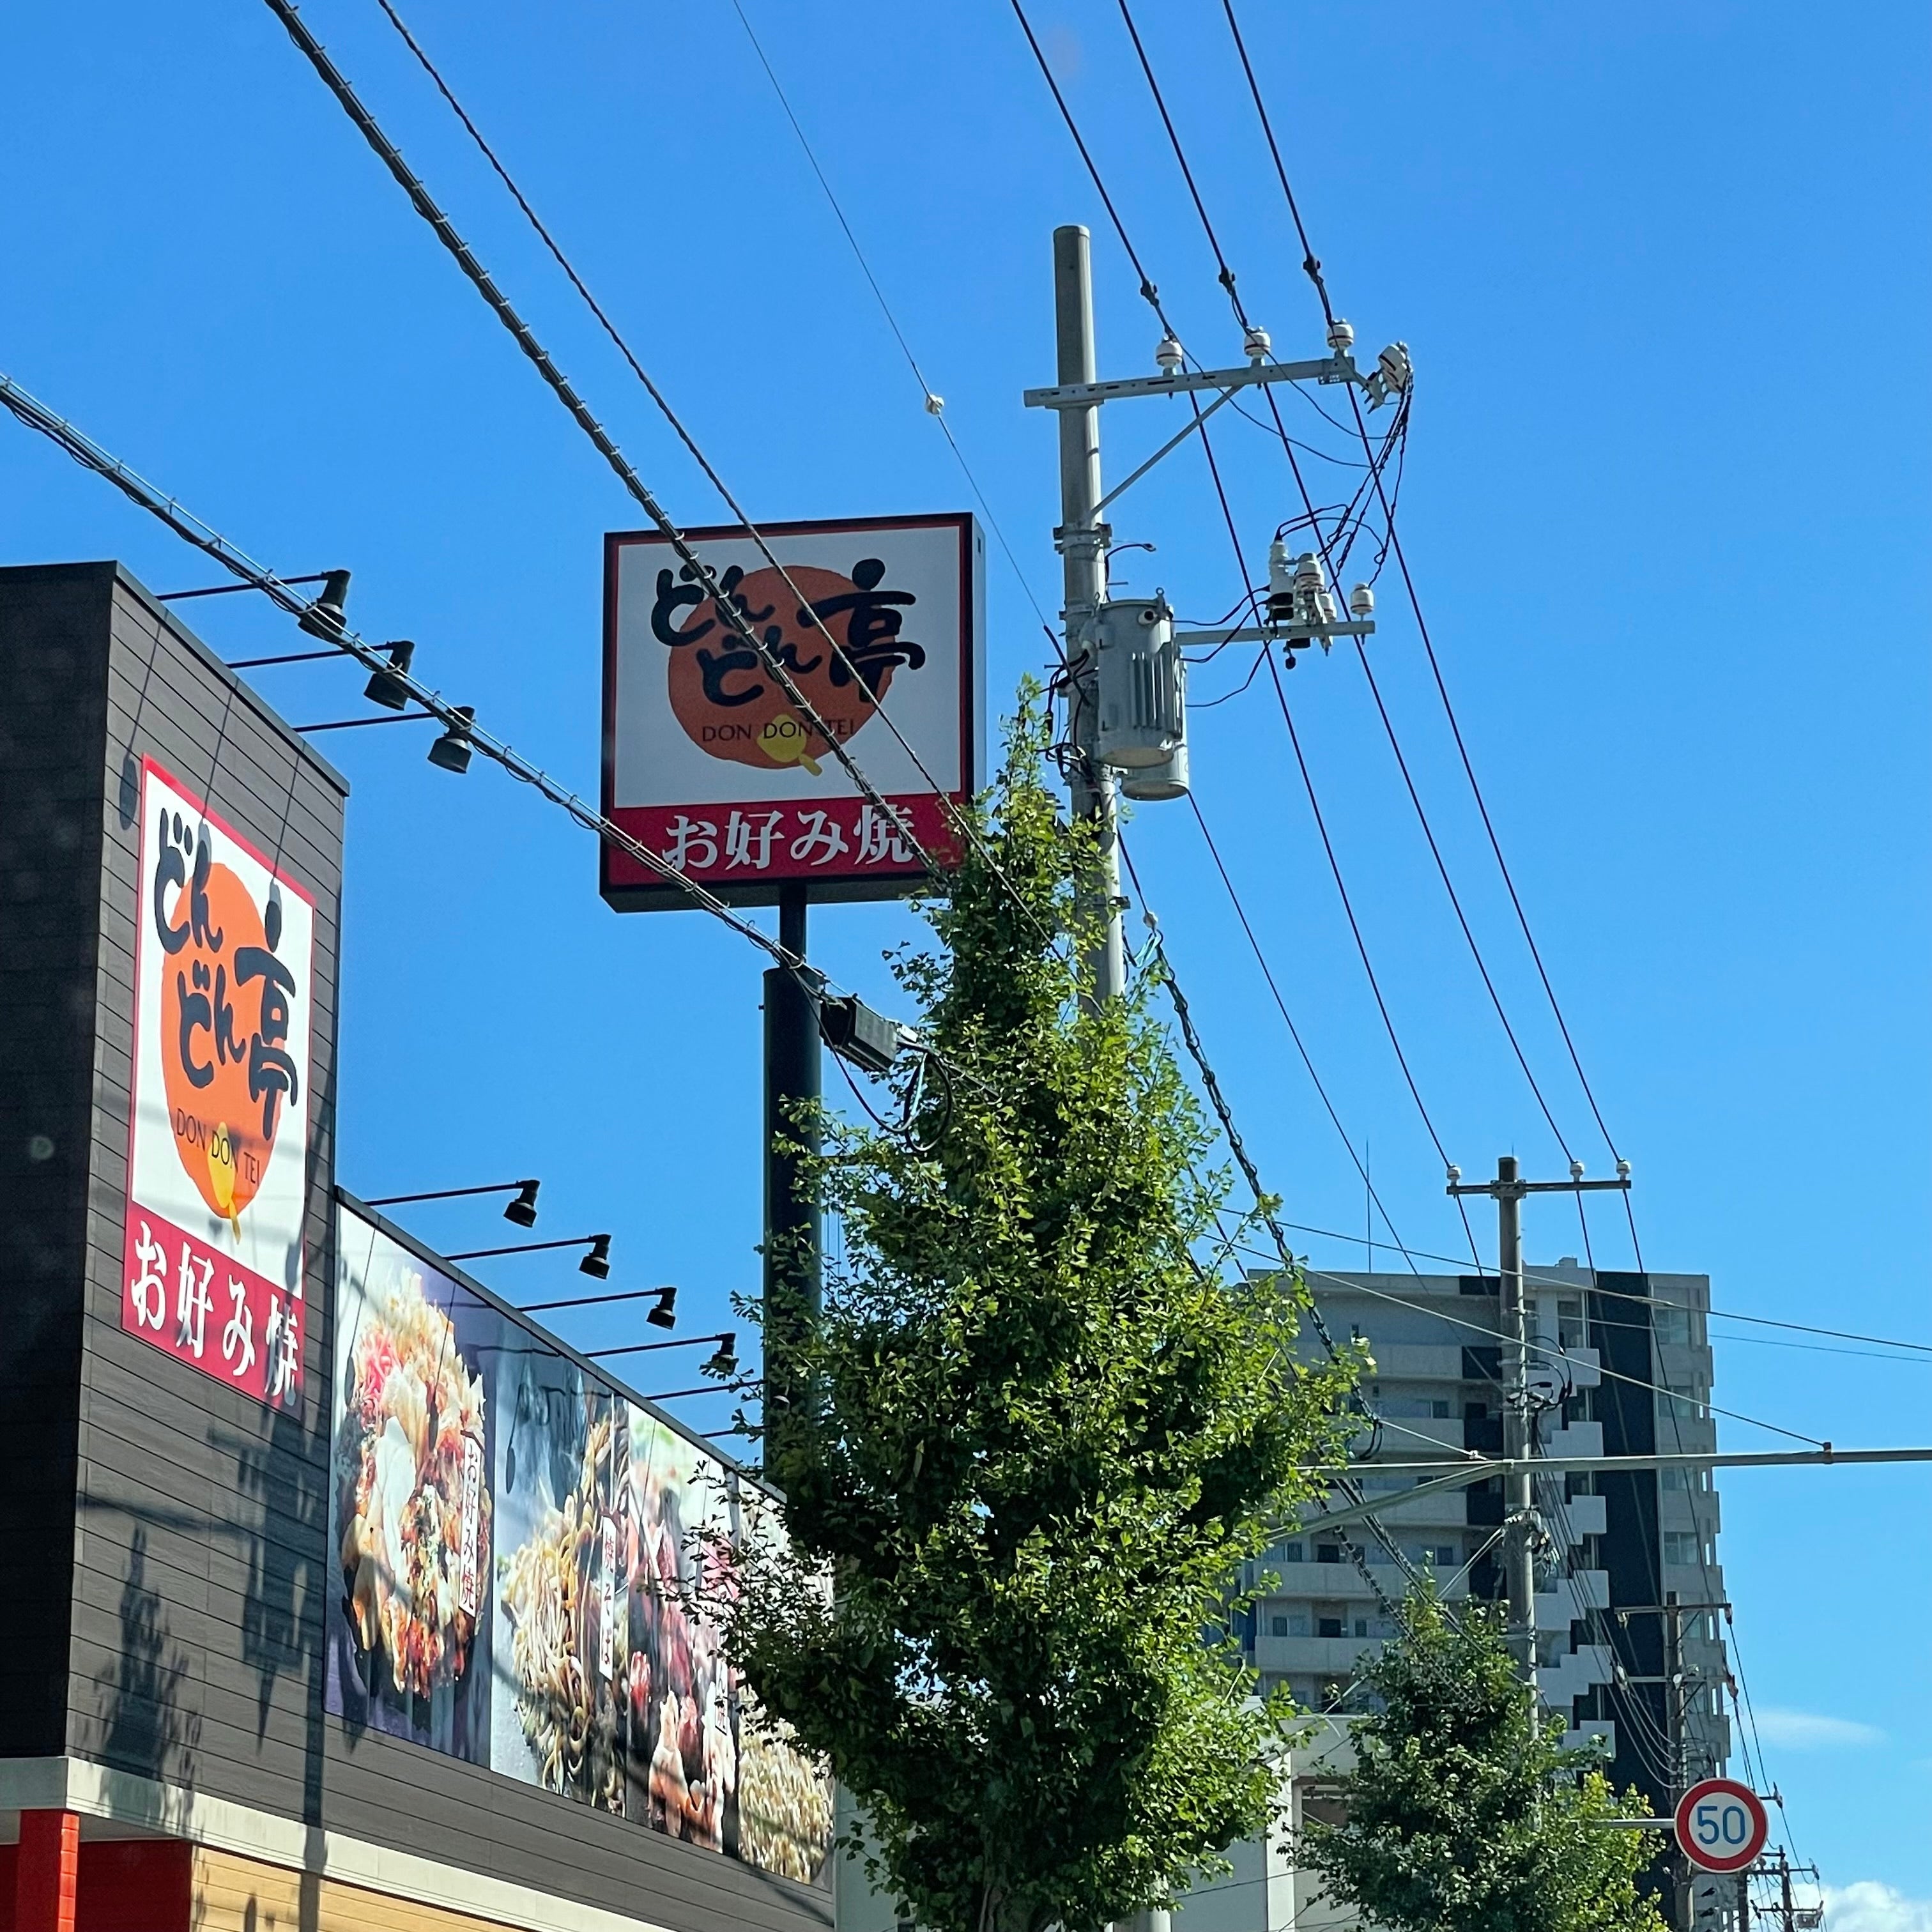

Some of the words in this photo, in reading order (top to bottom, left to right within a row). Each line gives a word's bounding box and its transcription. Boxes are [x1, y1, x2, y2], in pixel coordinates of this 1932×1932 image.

[703, 724, 751, 742] DON
[764, 721, 812, 739] DON
[825, 719, 854, 735] TEI
[663, 804, 915, 871] お好み焼
[177, 1107, 206, 1151] DON
[211, 1130, 238, 1172] DON
[243, 1151, 259, 1187] TEI
[131, 1220, 298, 1406] お好み焼
[461, 1443, 478, 1609] お好み焼
[1697, 1806, 1745, 1844] 50
